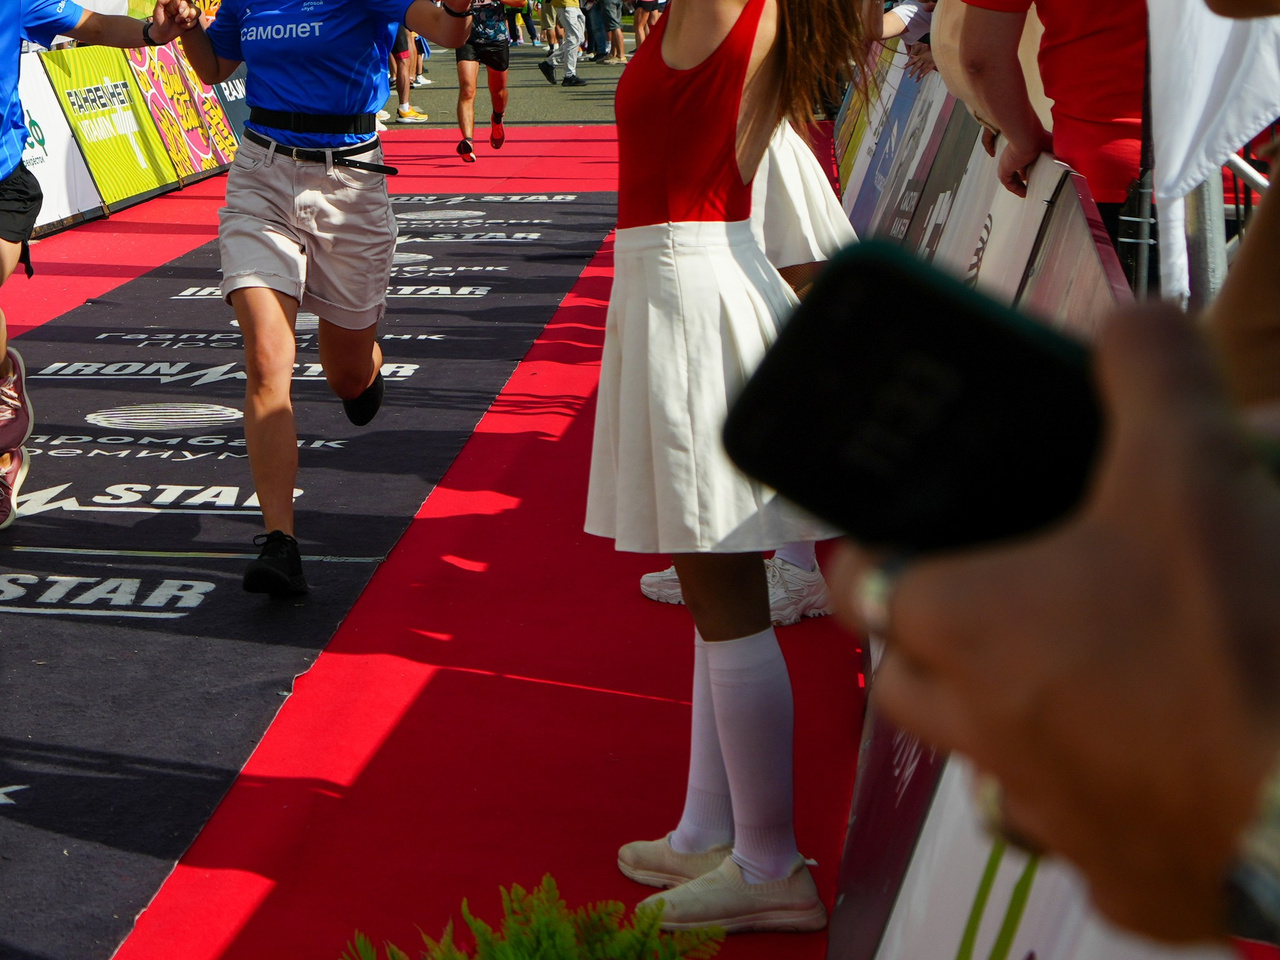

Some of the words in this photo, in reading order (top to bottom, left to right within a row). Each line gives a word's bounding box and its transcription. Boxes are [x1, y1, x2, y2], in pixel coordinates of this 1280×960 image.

[240, 21, 324, 42] самолет
[65, 80, 135, 117] FAHRENHEIT
[480, 194, 578, 202] STAR
[428, 232, 542, 240] STAR
[179, 287, 224, 296] IR
[37, 361, 191, 376] IRON
[291, 361, 420, 377] STR
[91, 483, 304, 507] STA
